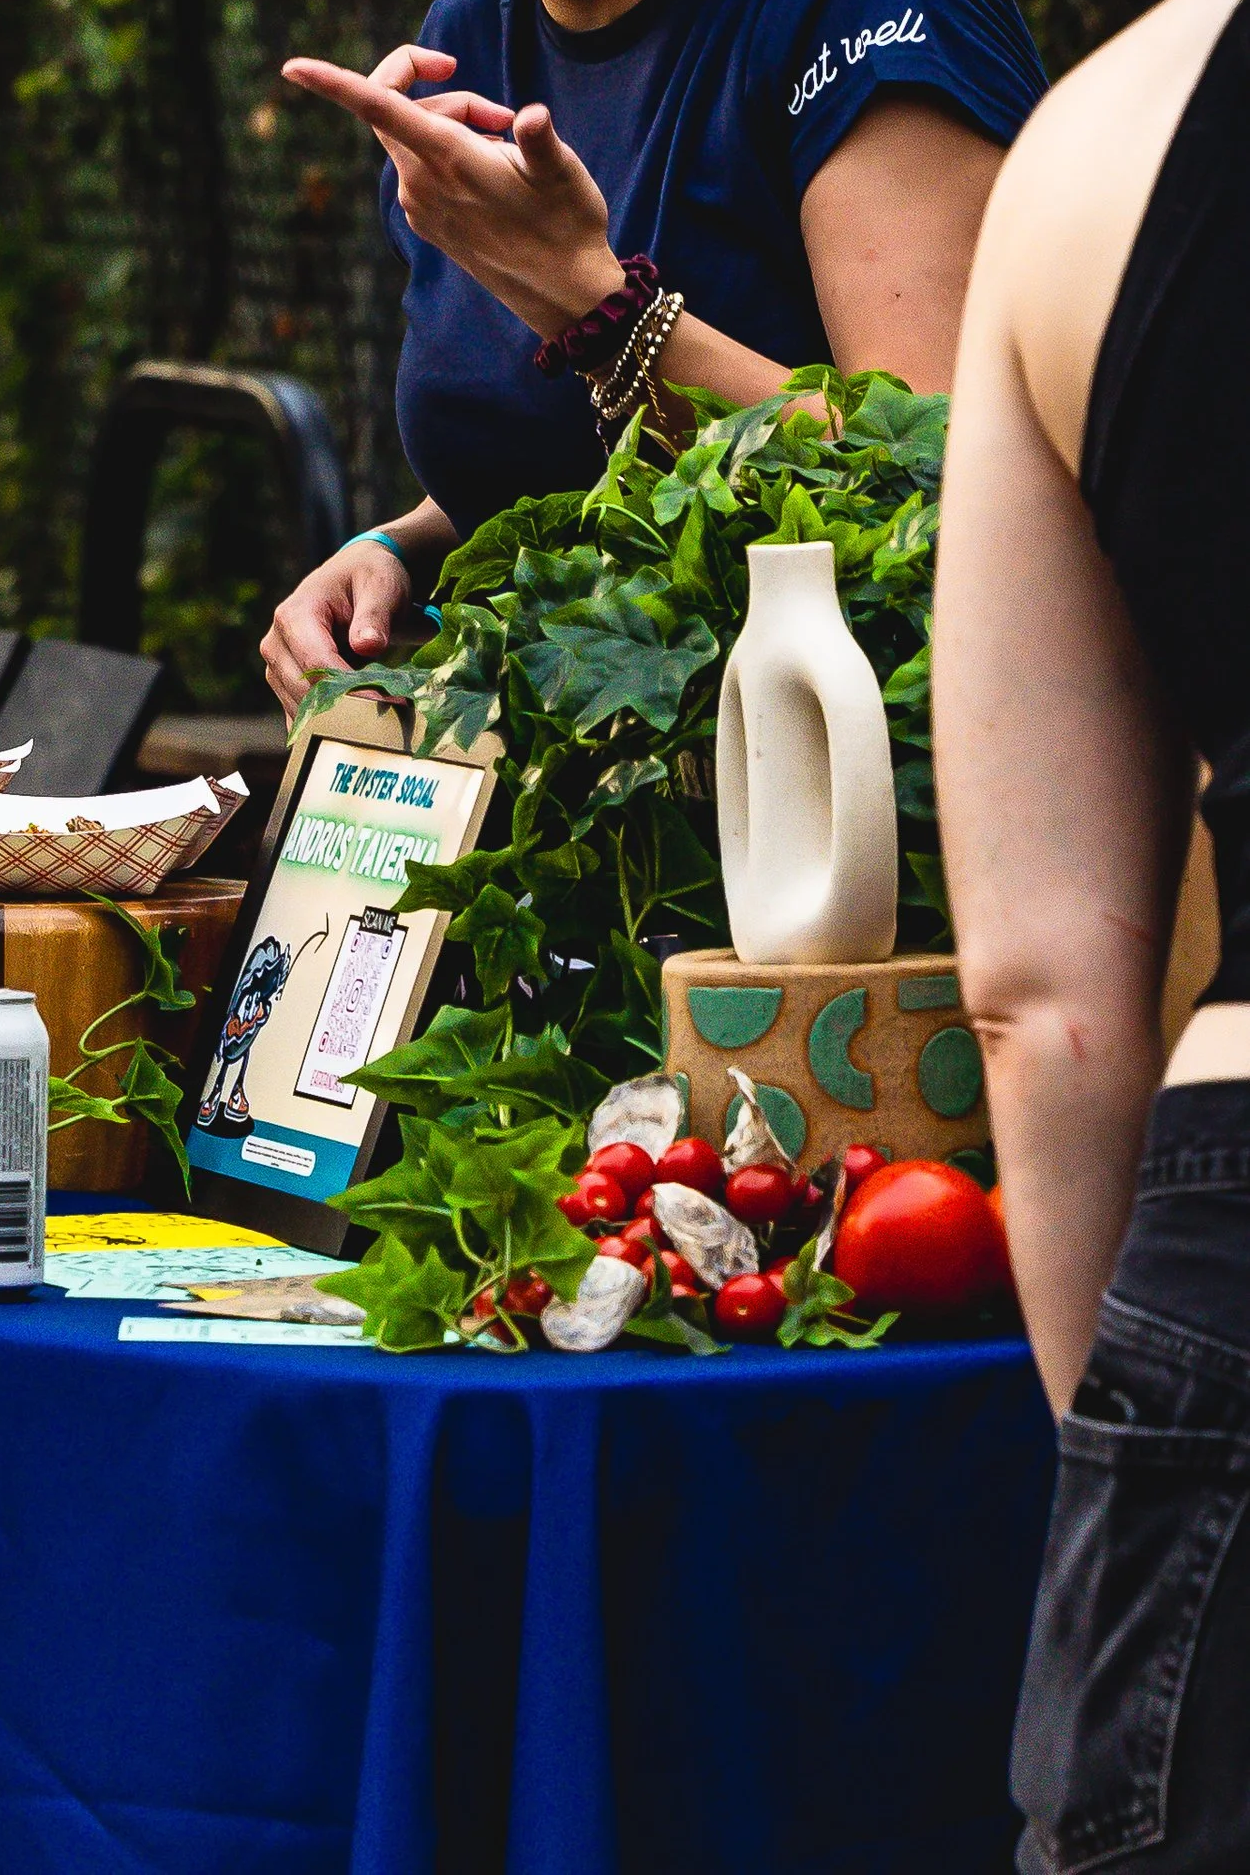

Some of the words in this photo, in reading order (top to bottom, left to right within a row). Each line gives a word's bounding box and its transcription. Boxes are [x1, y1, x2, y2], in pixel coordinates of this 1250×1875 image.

[787, 42, 838, 115] eat
[840, 8, 926, 64] well
[330, 762, 358, 794] THE
[352, 767, 400, 801] OYSTER
[395, 774, 440, 809] SOCIAL
[281, 815, 356, 871] ANDROS
[362, 910, 384, 931] SCAN
[381, 915, 396, 934] ME
